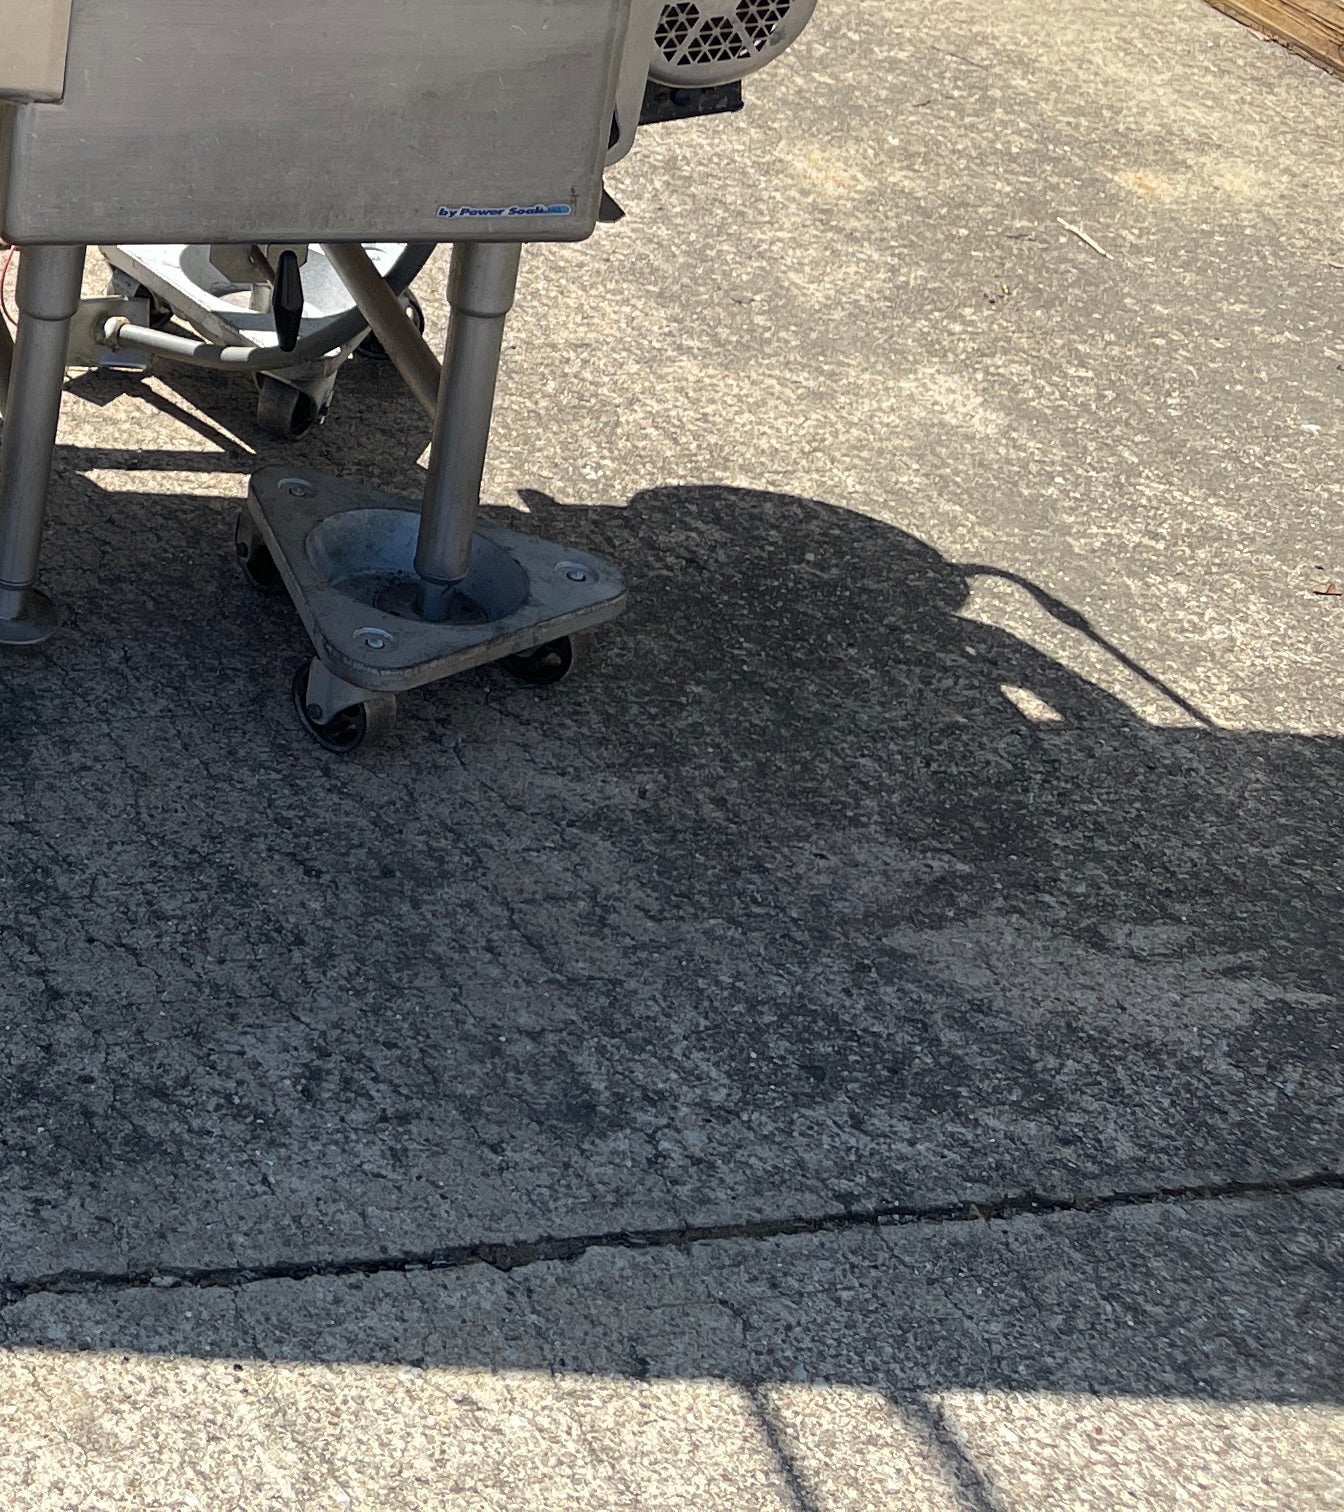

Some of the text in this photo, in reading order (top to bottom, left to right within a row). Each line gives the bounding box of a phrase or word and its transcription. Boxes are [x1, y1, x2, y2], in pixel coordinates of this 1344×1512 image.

[438, 206, 546, 218] by Power Soak
